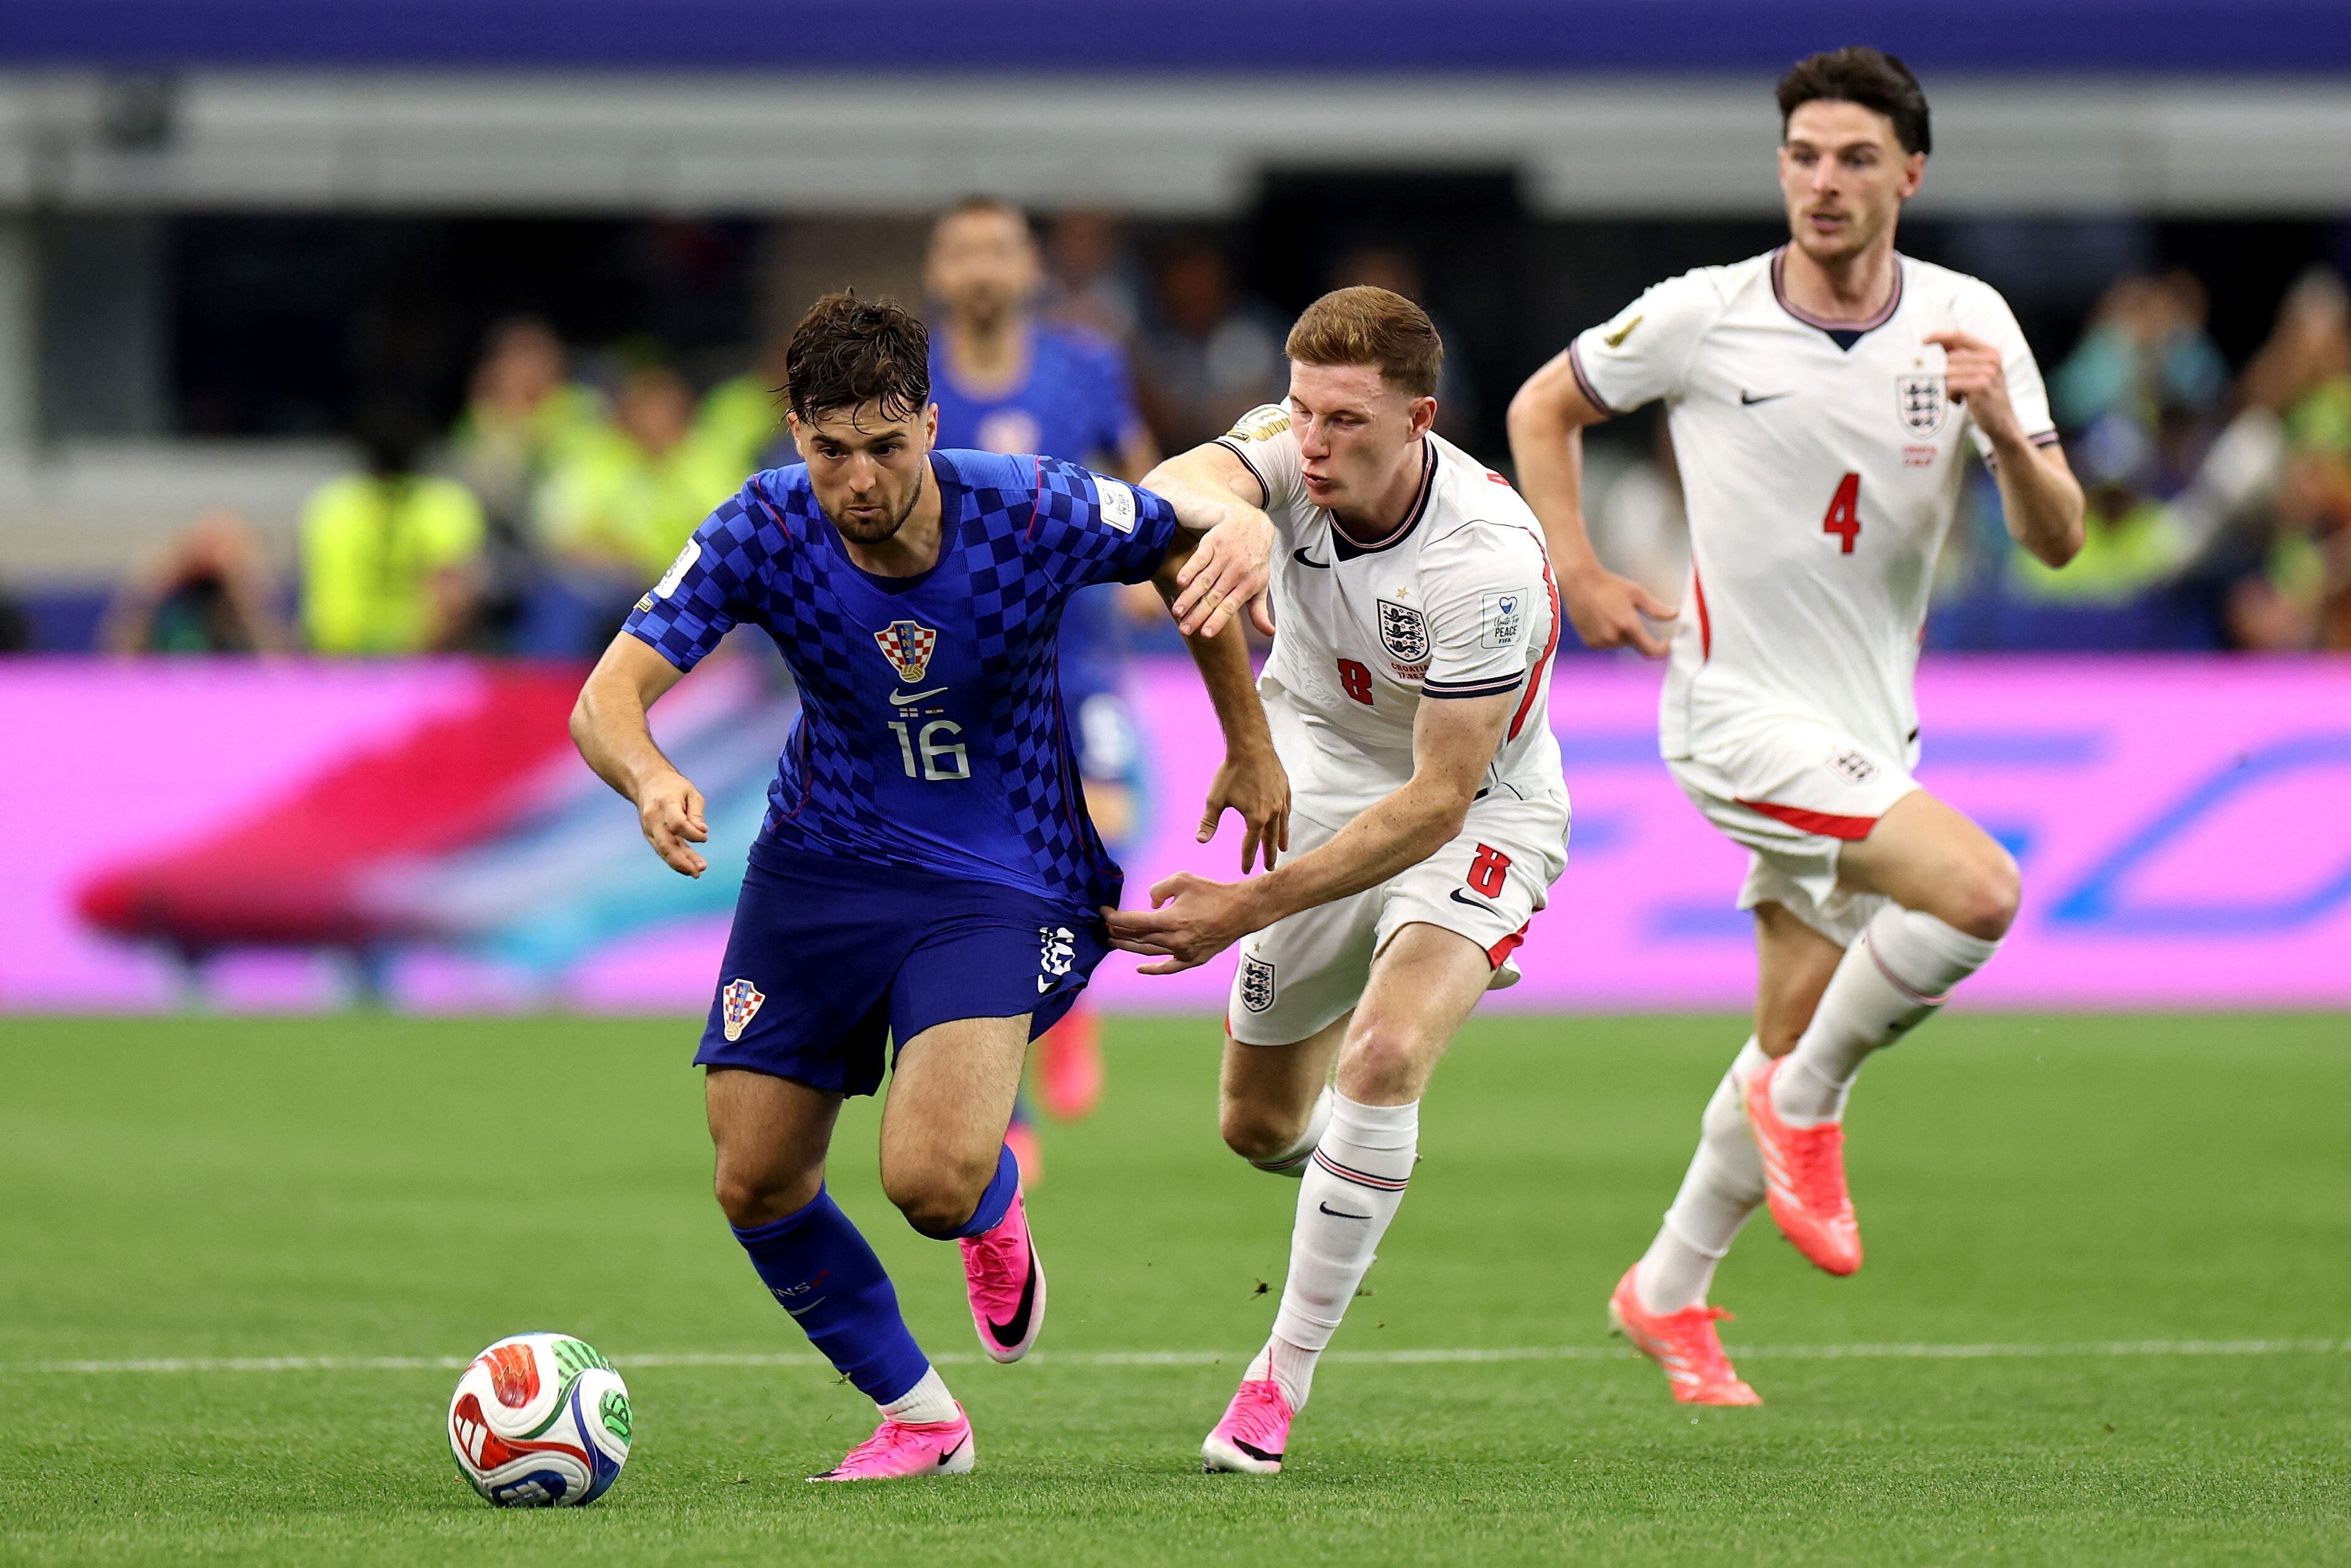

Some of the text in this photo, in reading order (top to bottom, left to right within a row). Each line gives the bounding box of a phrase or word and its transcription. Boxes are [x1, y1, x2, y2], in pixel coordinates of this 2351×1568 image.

[1824, 472, 1861, 553] 4
[1495, 625, 1517, 638] PEACE
[1337, 658, 1374, 706] 8
[1392, 662, 1429, 672] CROATIA
[888, 720, 971, 780] 16
[1466, 842, 1512, 899] 8
